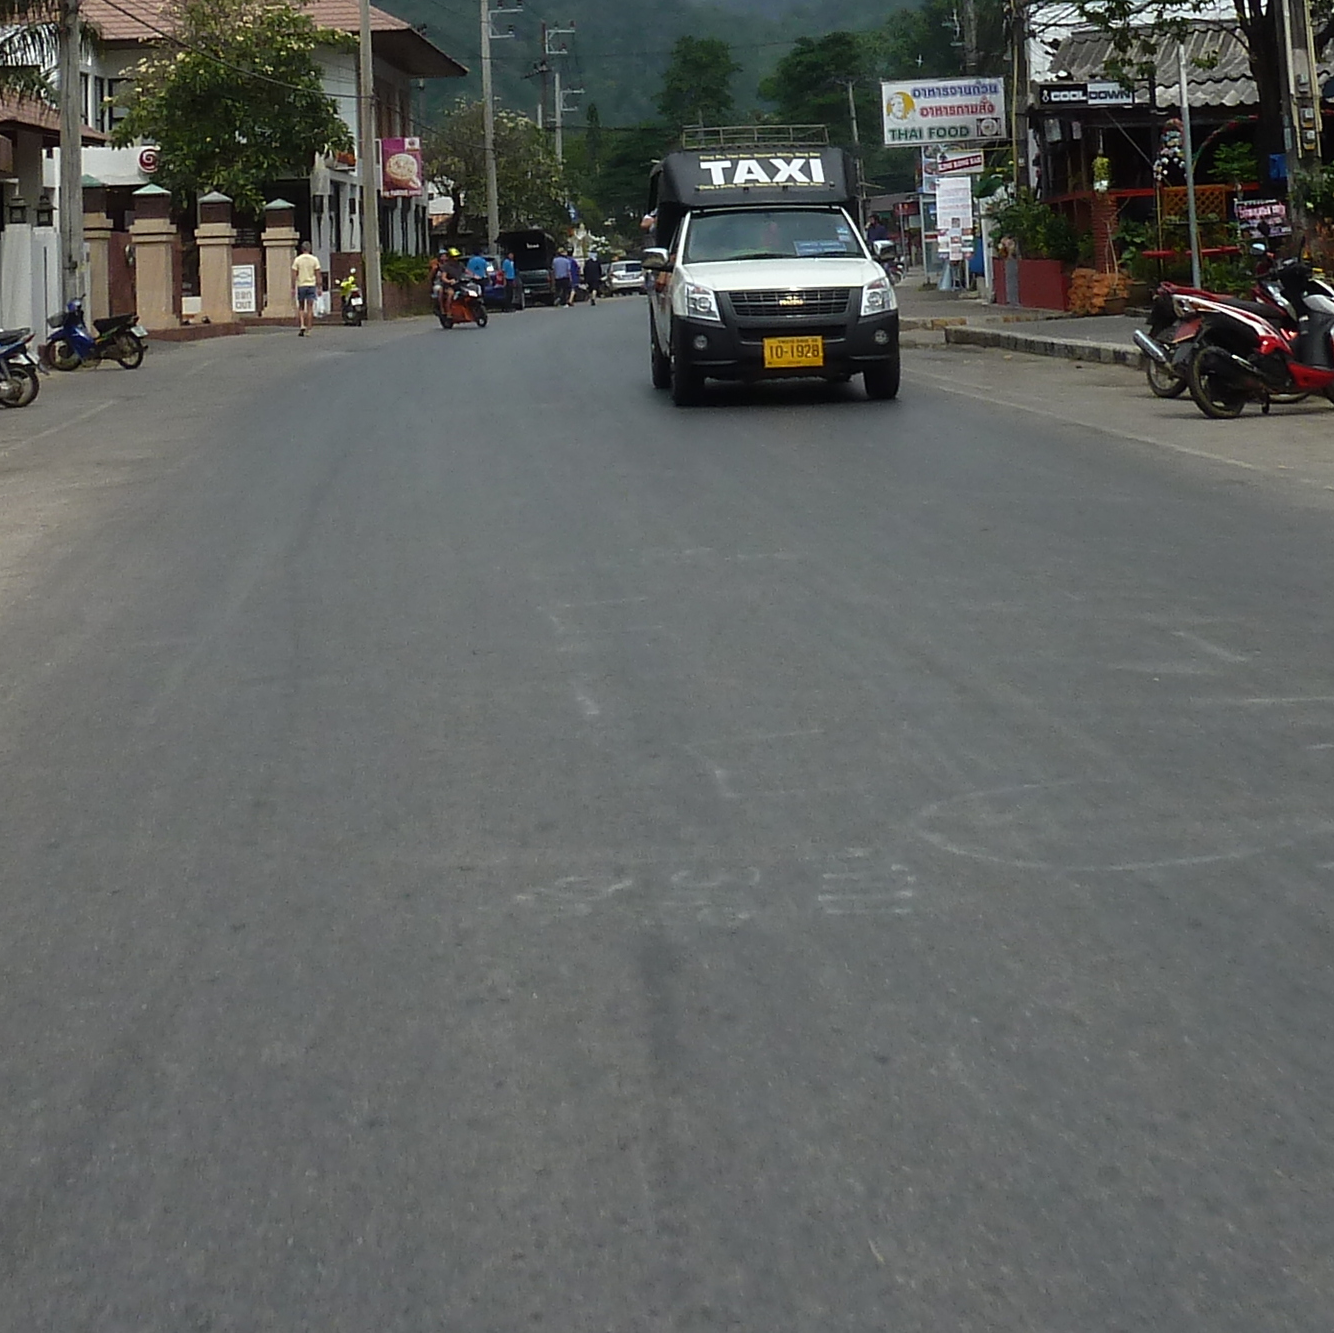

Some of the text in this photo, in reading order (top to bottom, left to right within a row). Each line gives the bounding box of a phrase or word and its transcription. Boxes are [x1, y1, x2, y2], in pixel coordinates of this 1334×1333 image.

[1050, 88, 1131, 102] COOL DOWN
[889, 125, 969, 142] THAI FOOD
[700, 158, 825, 185] TAXI
[769, 344, 820, 360] 10-1928
